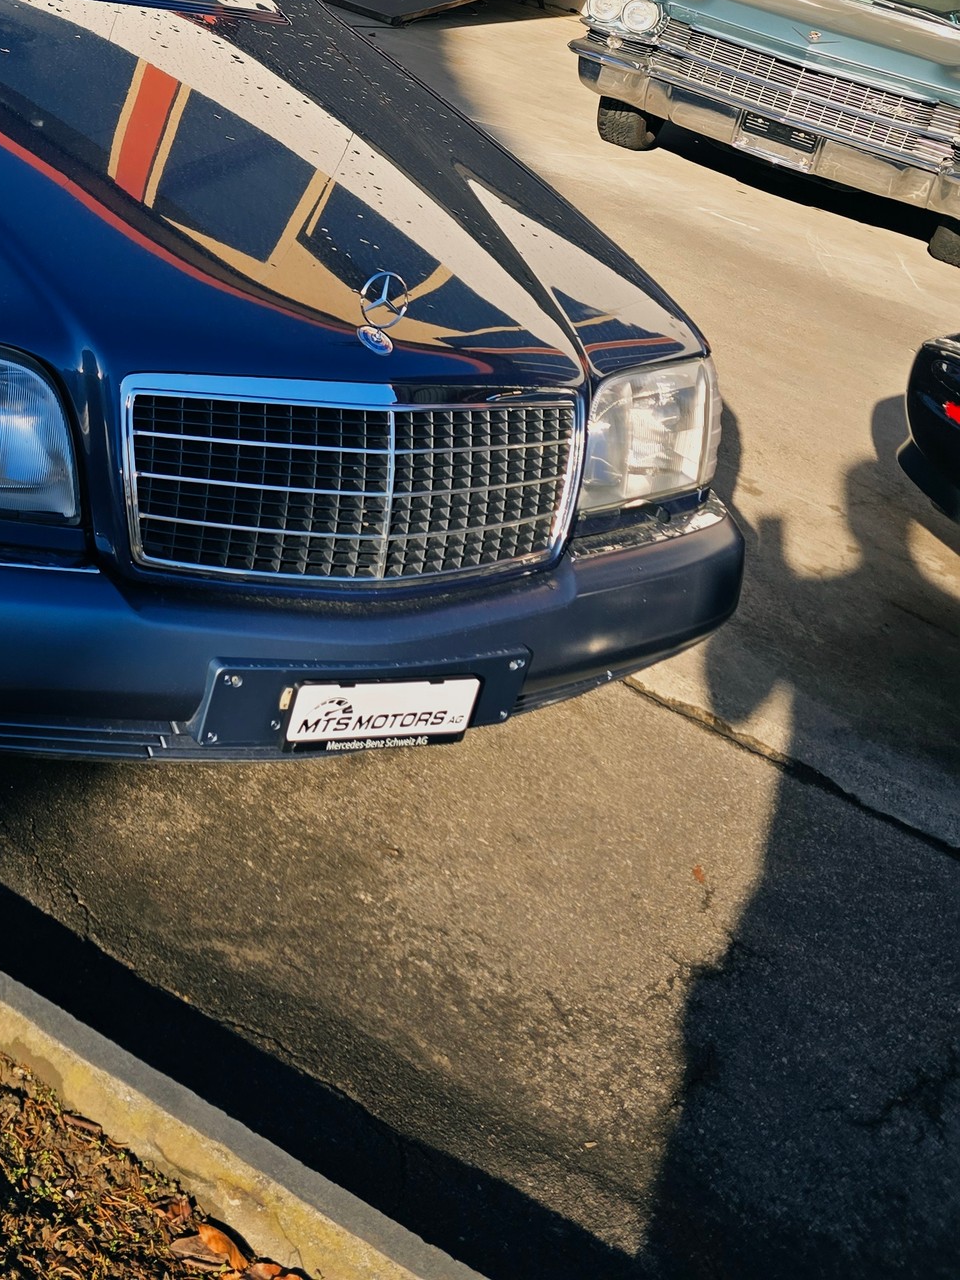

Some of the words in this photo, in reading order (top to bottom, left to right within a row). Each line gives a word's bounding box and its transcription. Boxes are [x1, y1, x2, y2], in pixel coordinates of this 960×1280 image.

[296, 716, 353, 734] MTS
[352, 710, 448, 732] MOTORS
[448, 715, 464, 724] AG
[326, 738, 385, 751] Mercedes-Benz
[385, 736, 415, 748] Schweiz
[415, 735, 429, 745] AG
